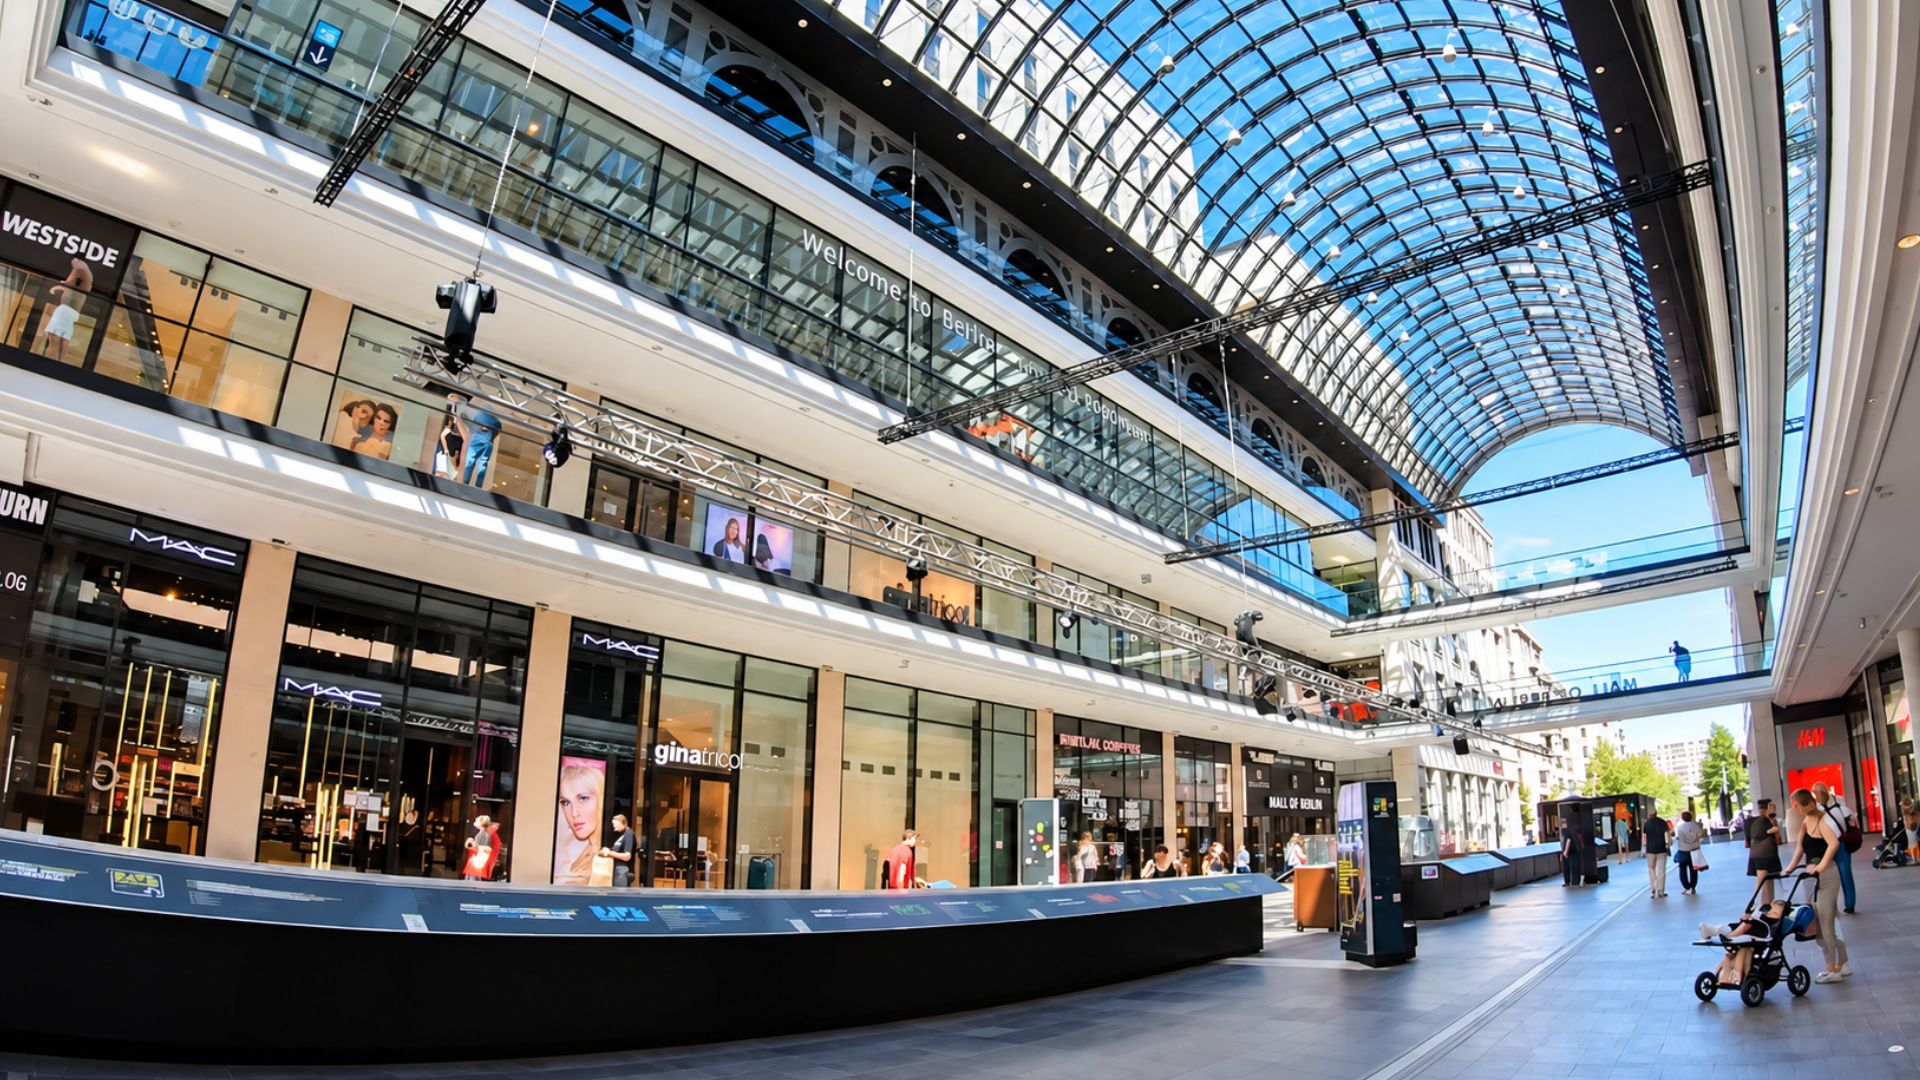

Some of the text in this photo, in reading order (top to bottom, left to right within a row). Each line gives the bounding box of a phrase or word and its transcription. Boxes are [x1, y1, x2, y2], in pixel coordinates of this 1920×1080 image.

[1, 210, 120, 268] WESTSIDE
[802, 228, 902, 302] Welcome
[910, 291, 932, 318] to
[0, 488, 49, 525] URN
[0, 571, 28, 592] OG
[1797, 726, 1825, 750] H&M
[1269, 796, 1288, 809] MALL
[1289, 797, 1300, 809] OF
